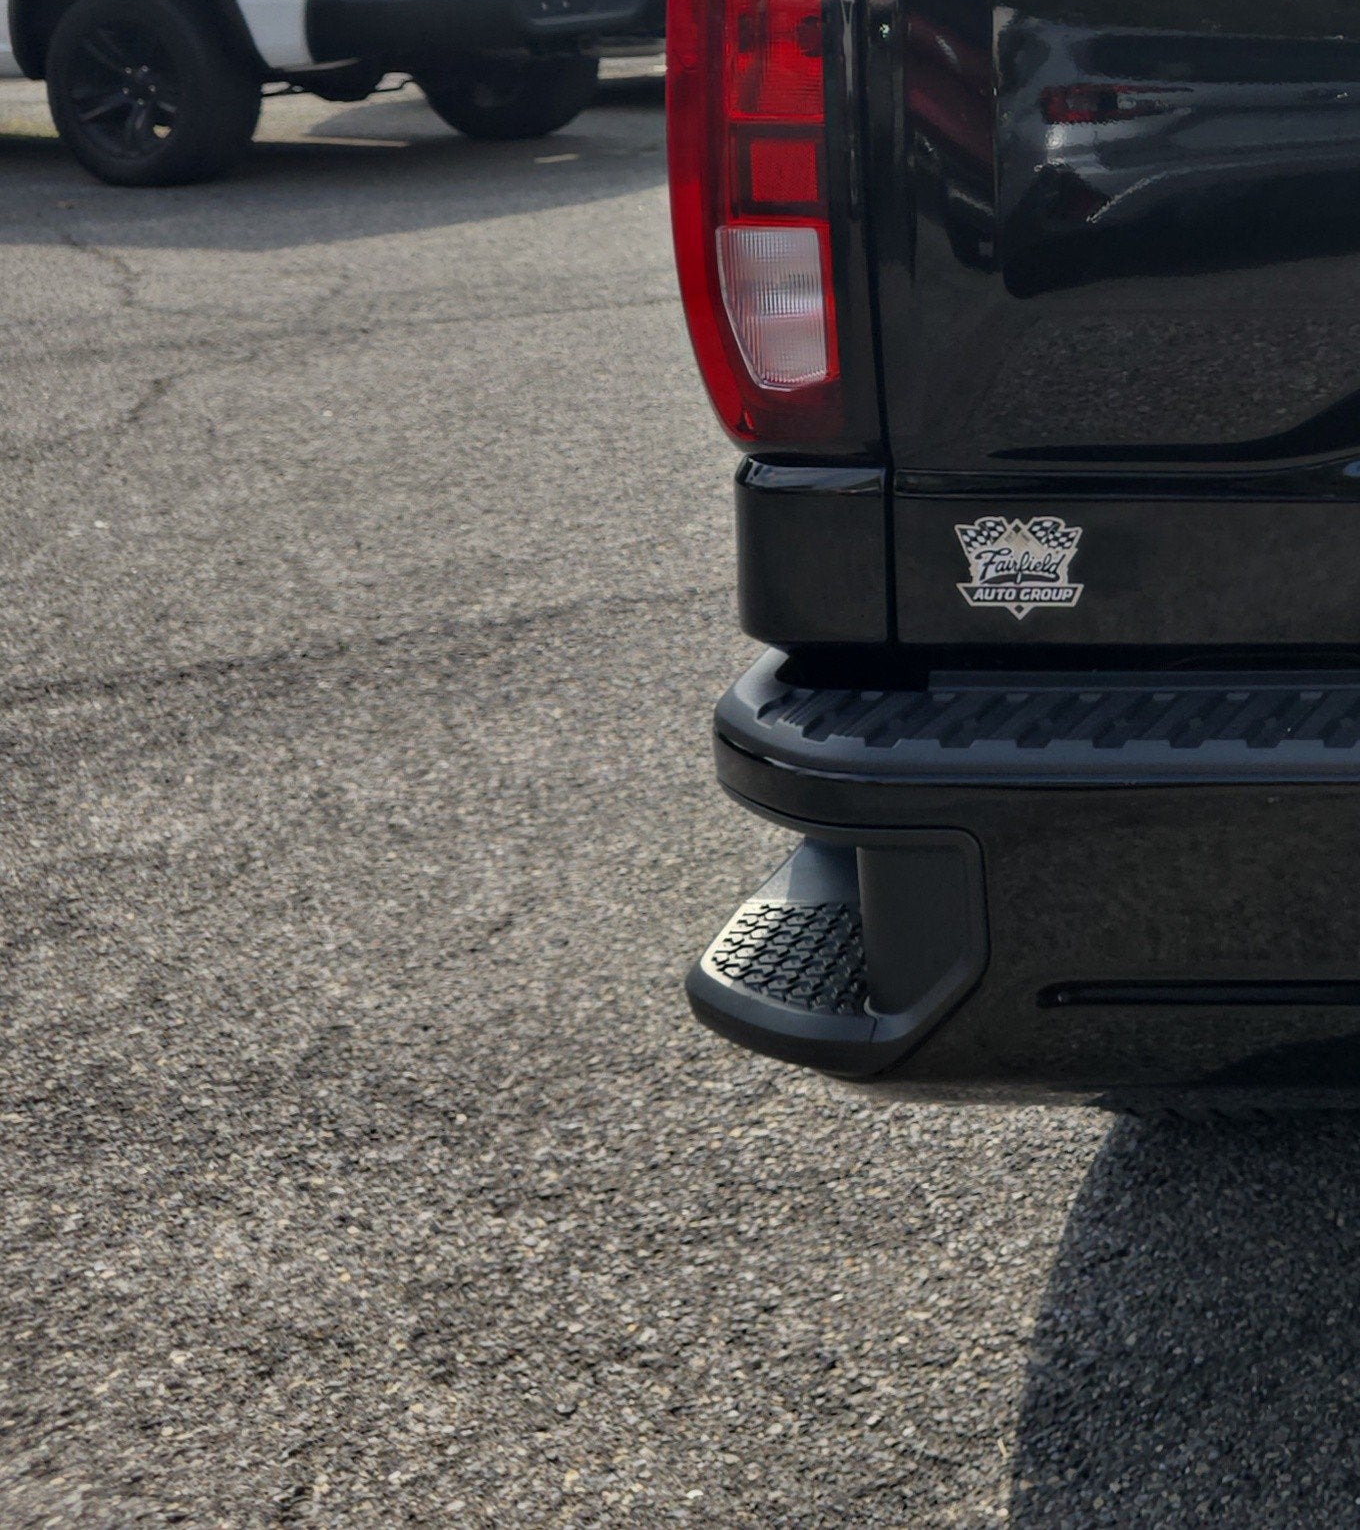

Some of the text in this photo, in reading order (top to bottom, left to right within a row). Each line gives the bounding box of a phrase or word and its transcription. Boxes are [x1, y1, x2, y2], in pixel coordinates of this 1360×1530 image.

[975, 547, 1067, 584] Fairfield
[973, 588, 1073, 600] AUTO GROUP
